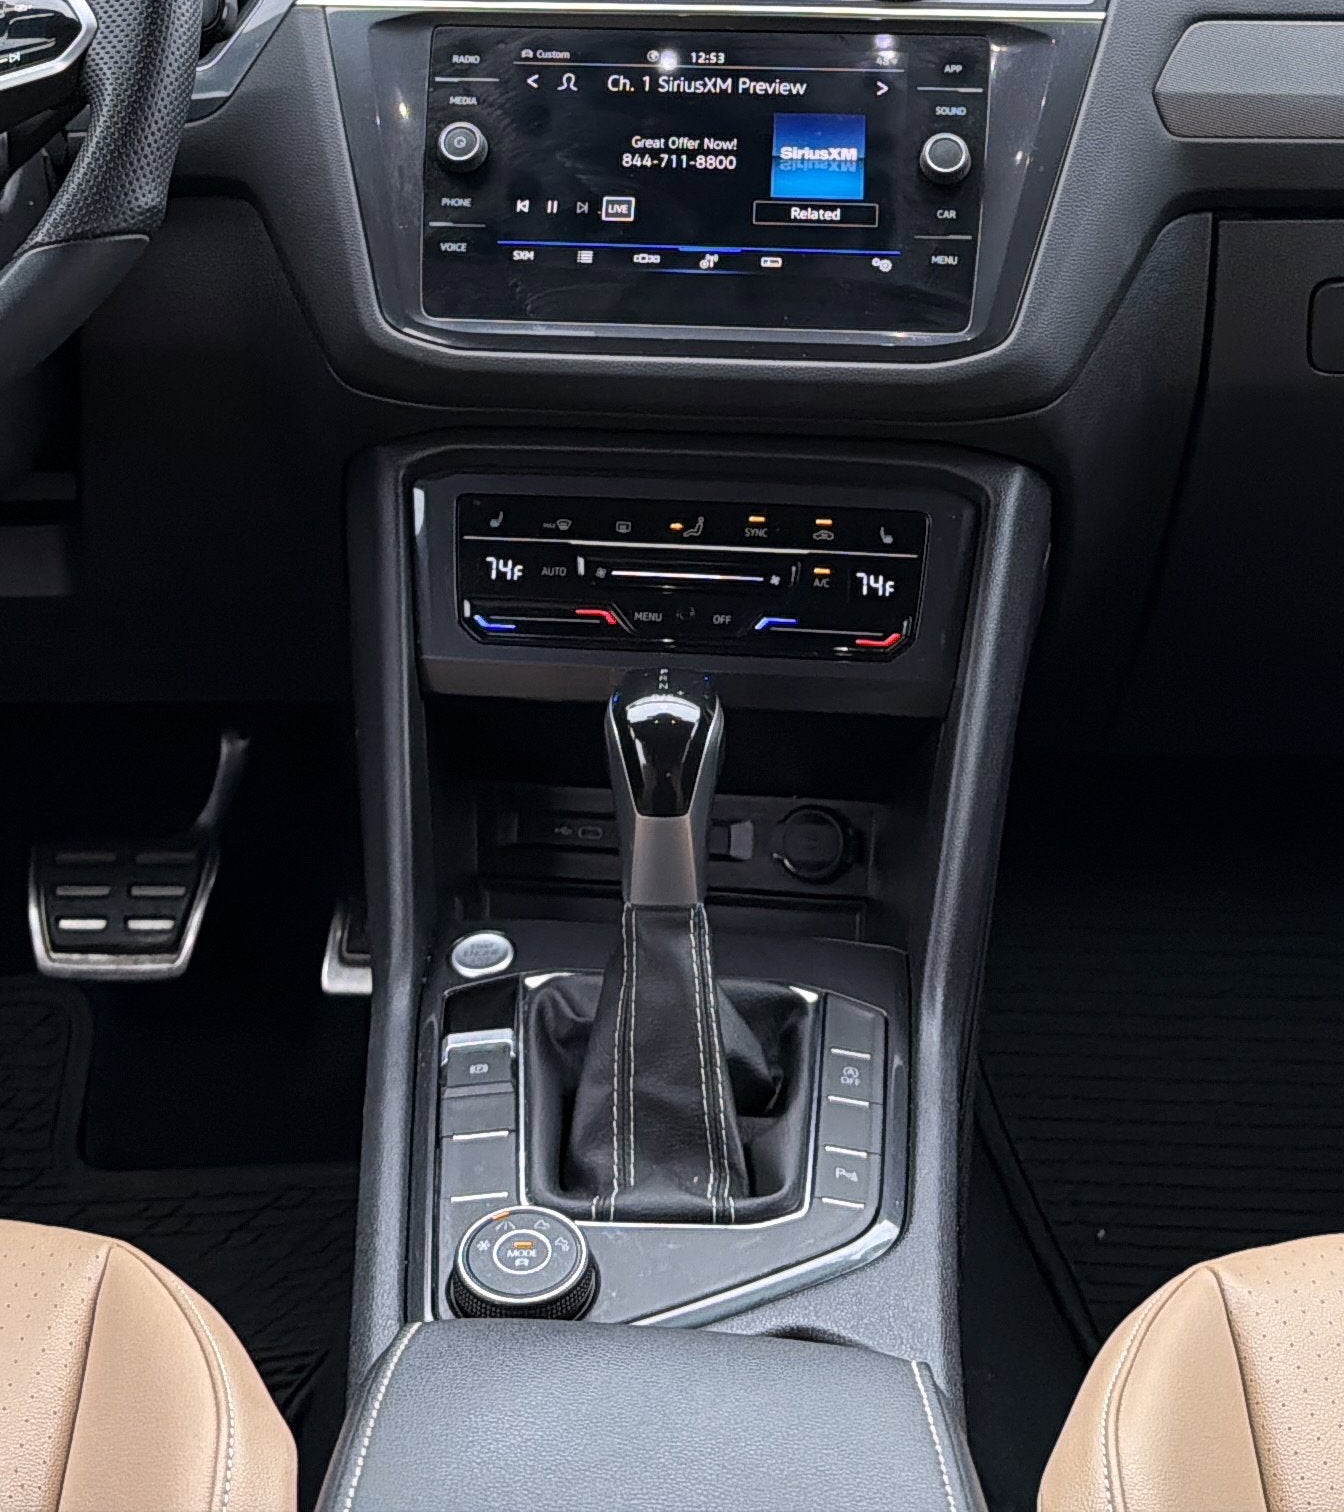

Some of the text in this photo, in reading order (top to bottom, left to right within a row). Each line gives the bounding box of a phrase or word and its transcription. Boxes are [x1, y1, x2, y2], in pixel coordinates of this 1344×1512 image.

[452, 55, 481, 64] RADIO
[536, 50, 571, 59] Custom
[690, 52, 726, 64] 12:53
[944, 64, 963, 73] APP
[608, 75, 807, 96] Ch. 1 SiriusXM Preview
[450, 96, 477, 105] MEDIA
[935, 106, 966, 116] SOUND
[631, 136, 738, 151] Great Offer Now!
[779, 146, 858, 161] SiriusXM
[622, 154, 737, 170] 844-711-8800
[441, 197, 472, 207] PHONE
[608, 204, 628, 214] LIVE
[790, 207, 841, 221] Related
[937, 210, 956, 219] CAR
[440, 243, 467, 252] VOICE
[513, 250, 535, 261] SXM
[931, 255, 958, 265] MENU
[745, 528, 768, 538] SYNC
[485, 556, 524, 581] 74F
[541, 567, 567, 576] AUTO
[813, 578, 830, 588] A/C
[856, 572, 895, 597] 74F
[634, 612, 663, 622] MENU
[712, 615, 732, 625] OFF
[506, 1249, 537, 1257] MODE
